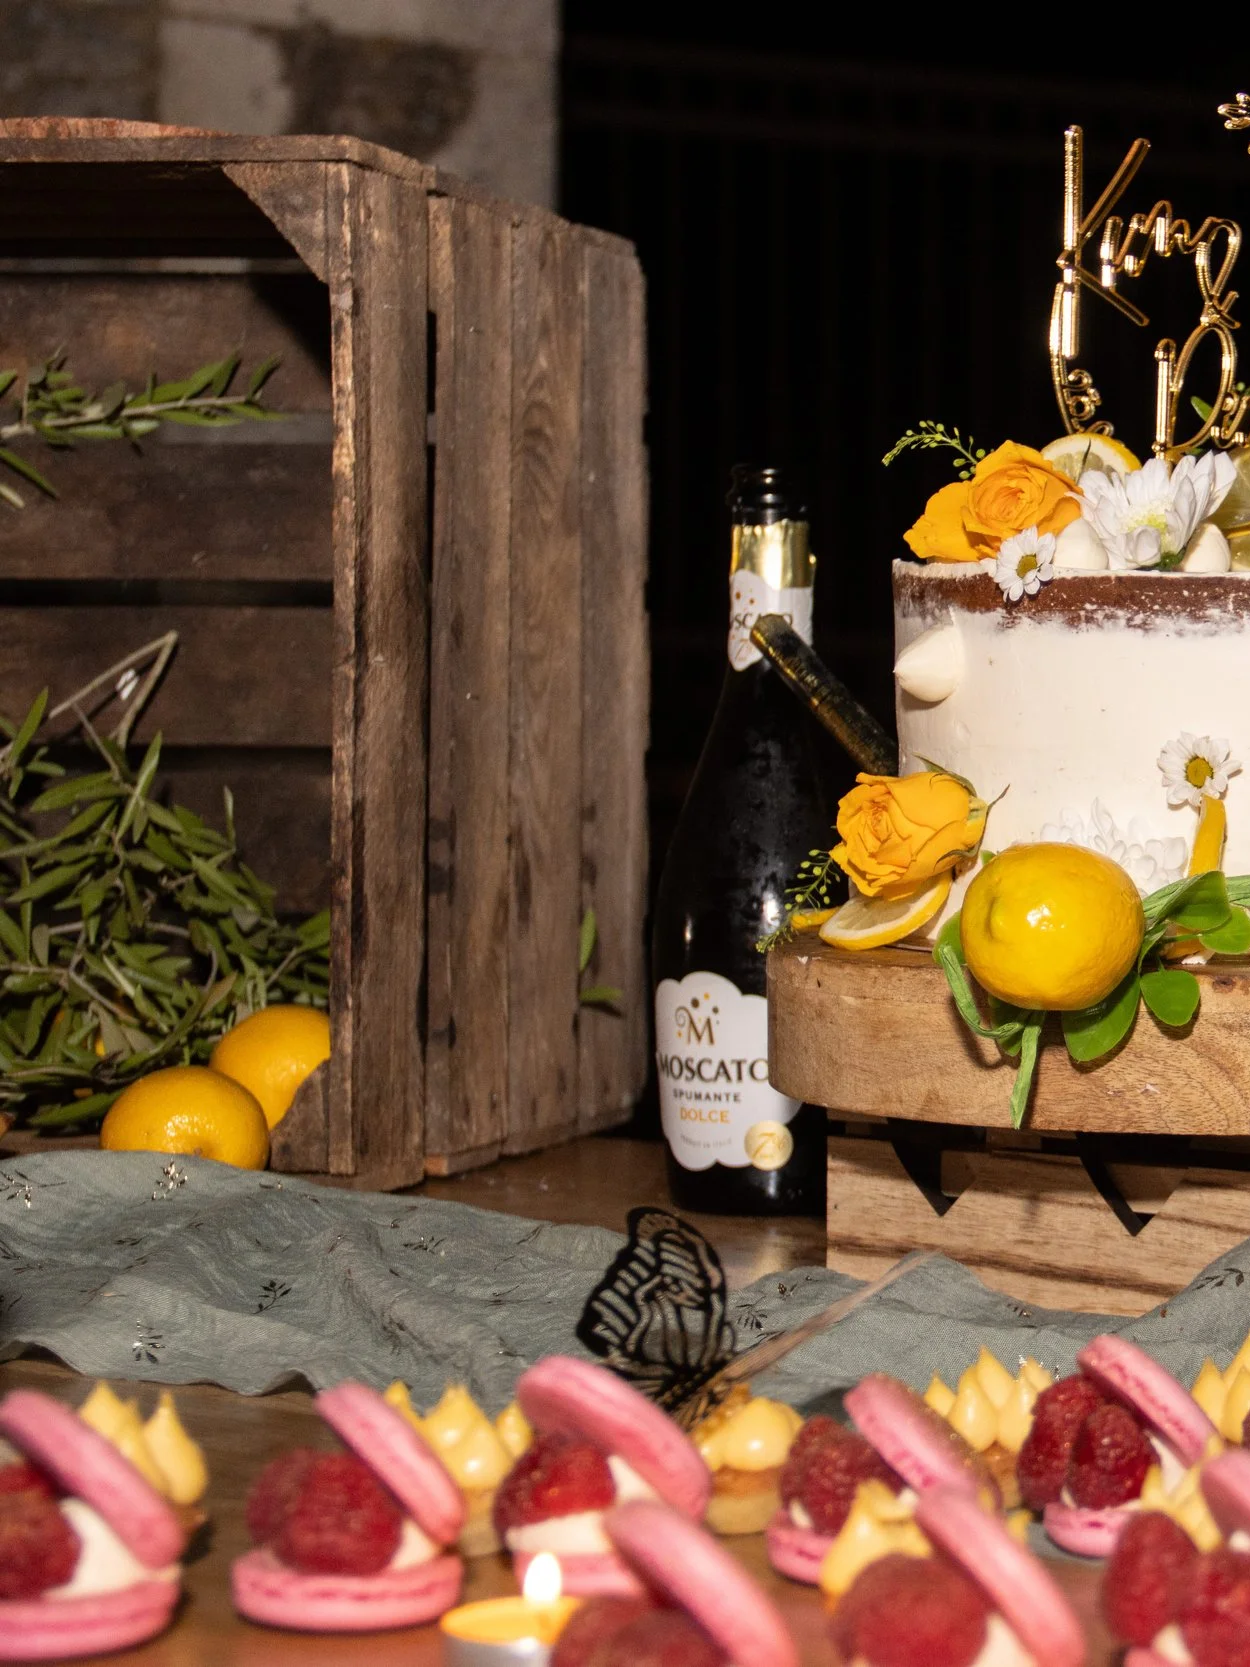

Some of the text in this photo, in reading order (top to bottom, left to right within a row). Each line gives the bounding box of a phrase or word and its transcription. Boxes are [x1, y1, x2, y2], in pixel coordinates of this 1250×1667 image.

[659, 1055, 769, 1083] MOSCATO
[673, 1088, 742, 1103] SPUMANTE
[679, 1106, 731, 1123] DOLCE
